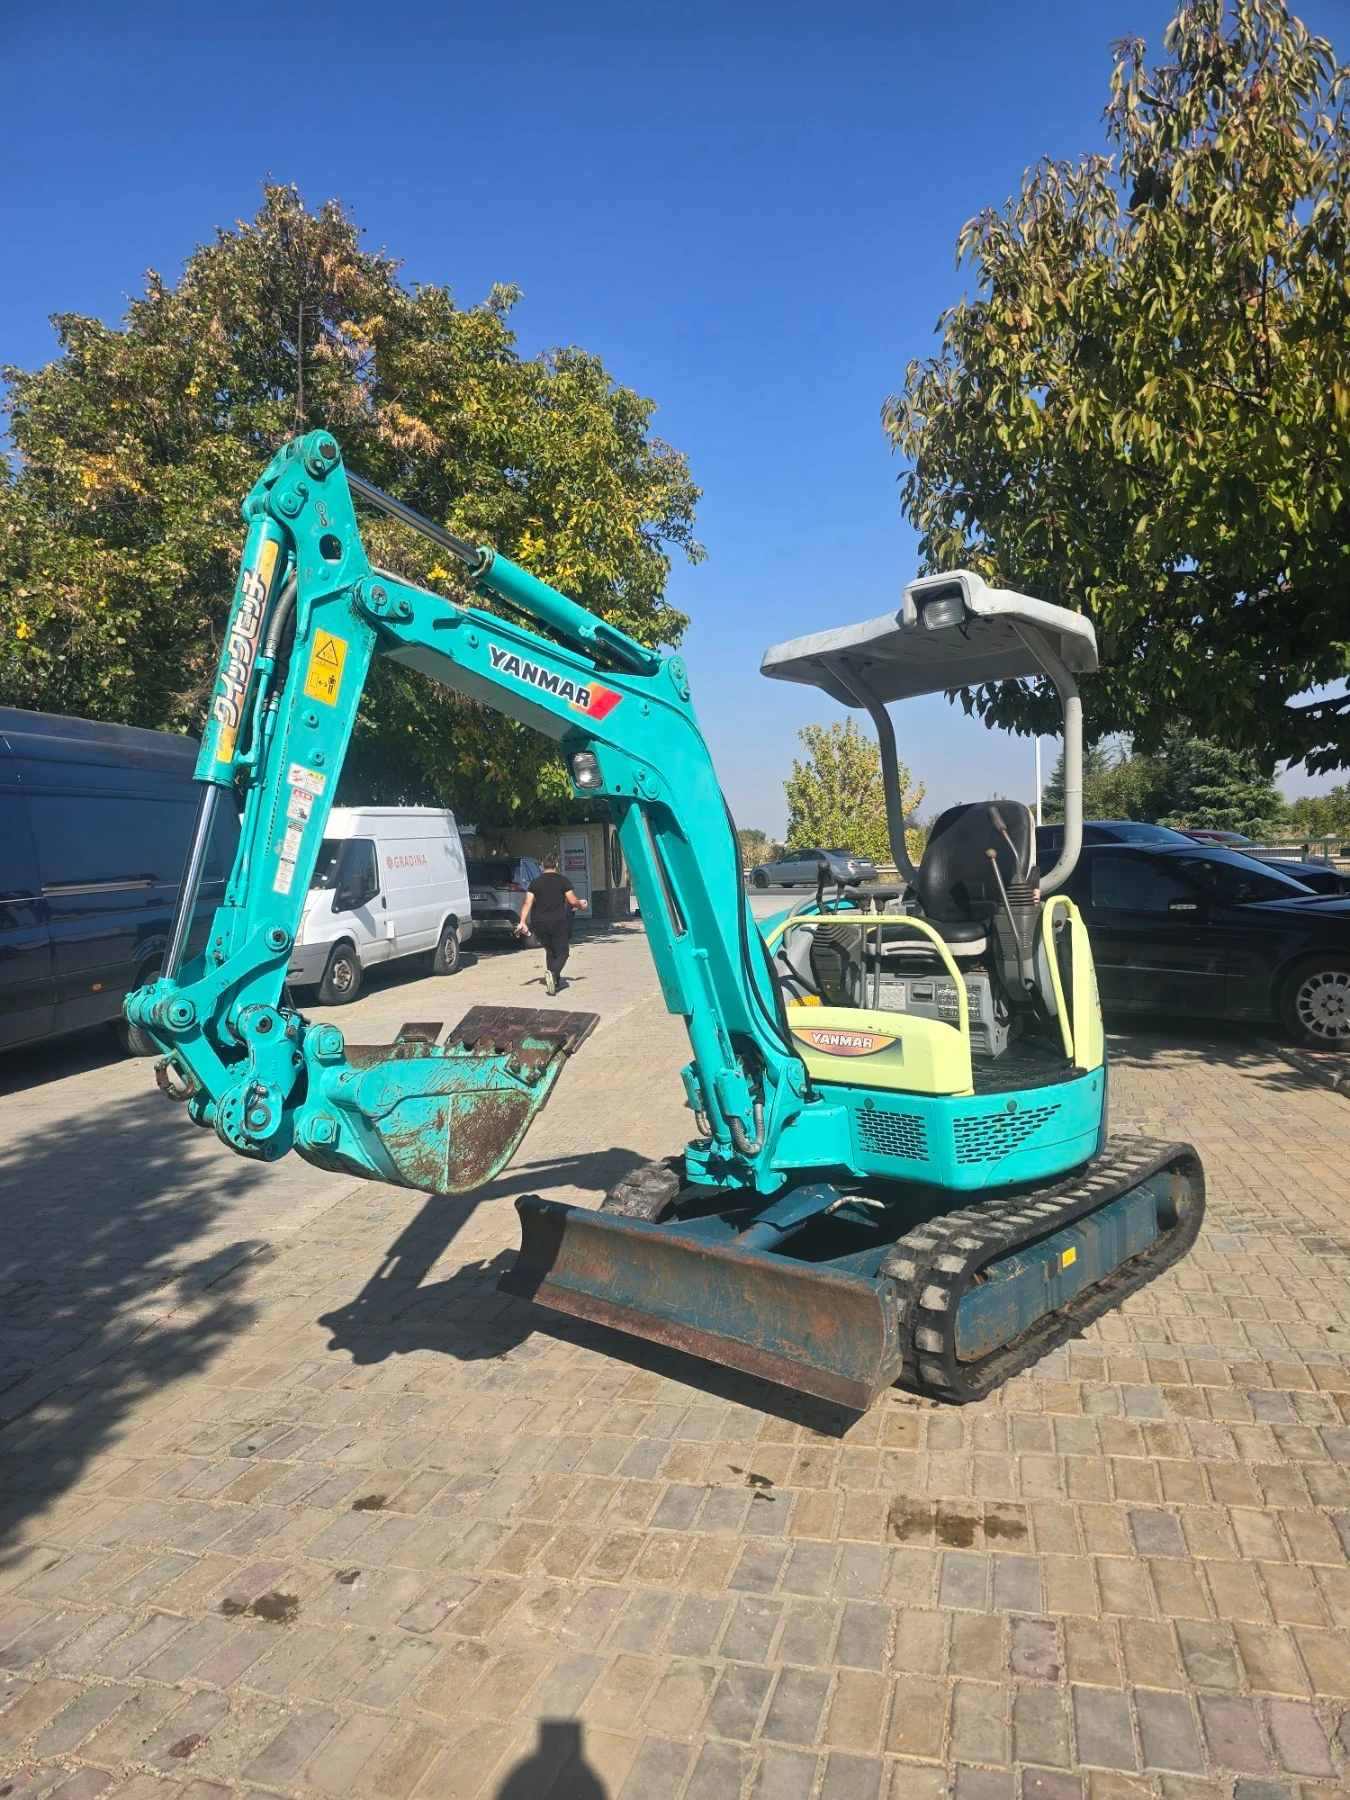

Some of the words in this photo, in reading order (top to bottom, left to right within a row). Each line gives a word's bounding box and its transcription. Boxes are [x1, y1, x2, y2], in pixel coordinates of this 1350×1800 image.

[213, 568, 267, 728] クイックヒッチ
[489, 644, 592, 709] YANMAR
[394, 854, 428, 868] GRADINA
[811, 1033, 874, 1049] YANMAR
